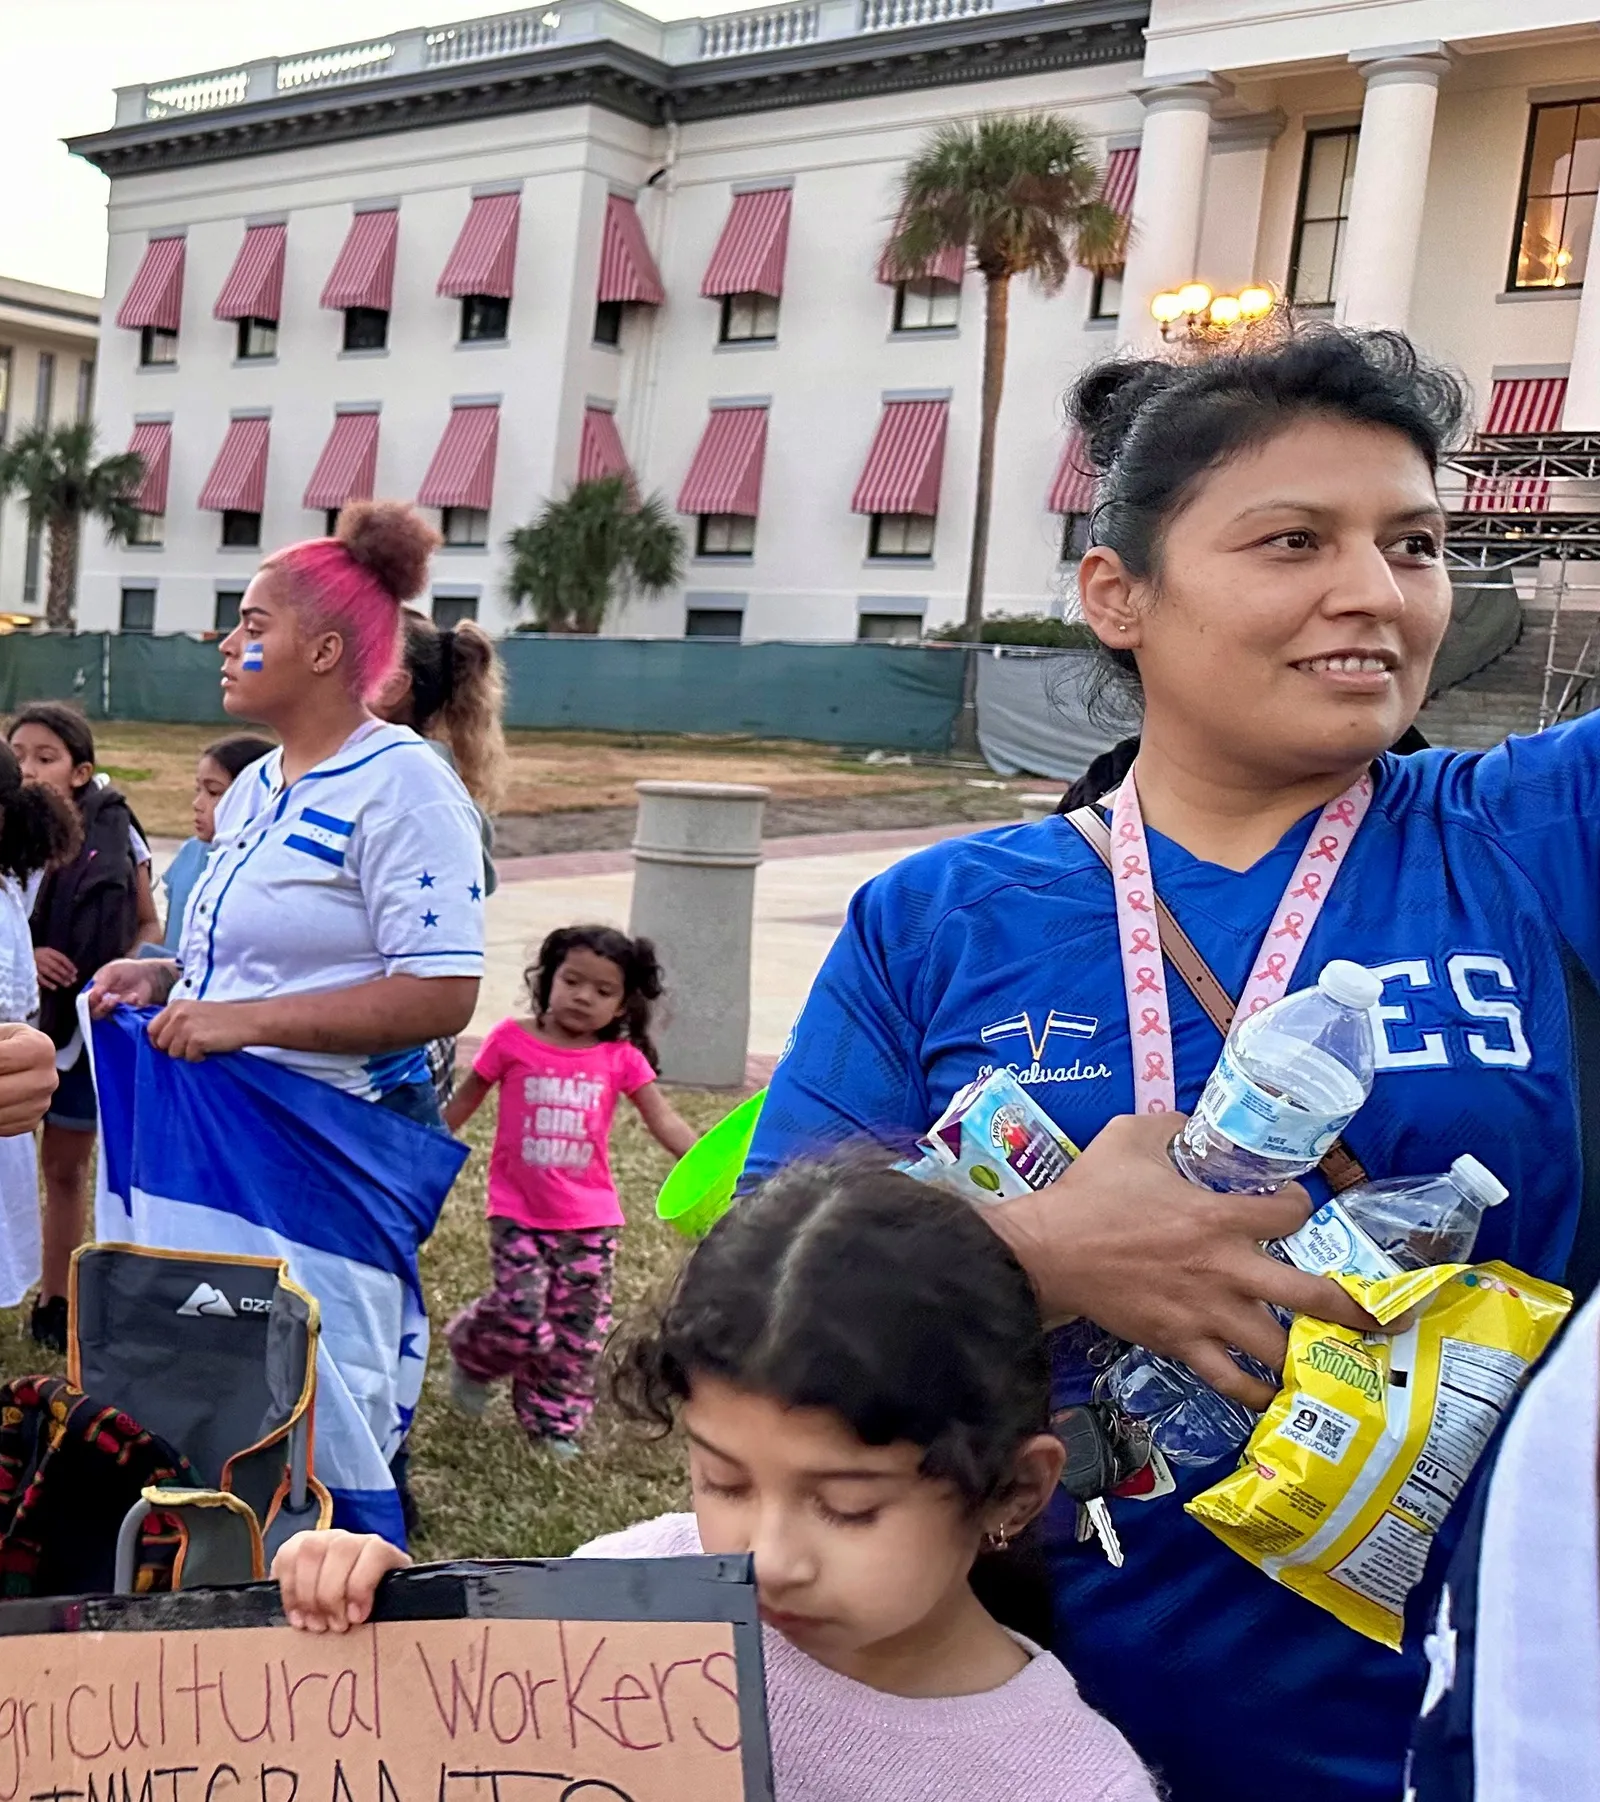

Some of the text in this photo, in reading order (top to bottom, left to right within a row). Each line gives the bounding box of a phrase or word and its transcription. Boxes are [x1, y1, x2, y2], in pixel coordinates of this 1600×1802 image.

[1360, 954, 1532, 1070] ES
[1005, 1058, 1113, 1085] Salvador
[523, 1076, 605, 1111] SMART
[535, 1106, 588, 1139] GIRL
[992, 1112, 1006, 1143] APPLE
[521, 1136, 595, 1170] SQUAD
[1307, 1240, 1331, 1266] Water
[1308, 1226, 1338, 1261] Drinking
[1415, 1459, 1440, 1480] 170
[1396, 1495, 1427, 1519] Facts
